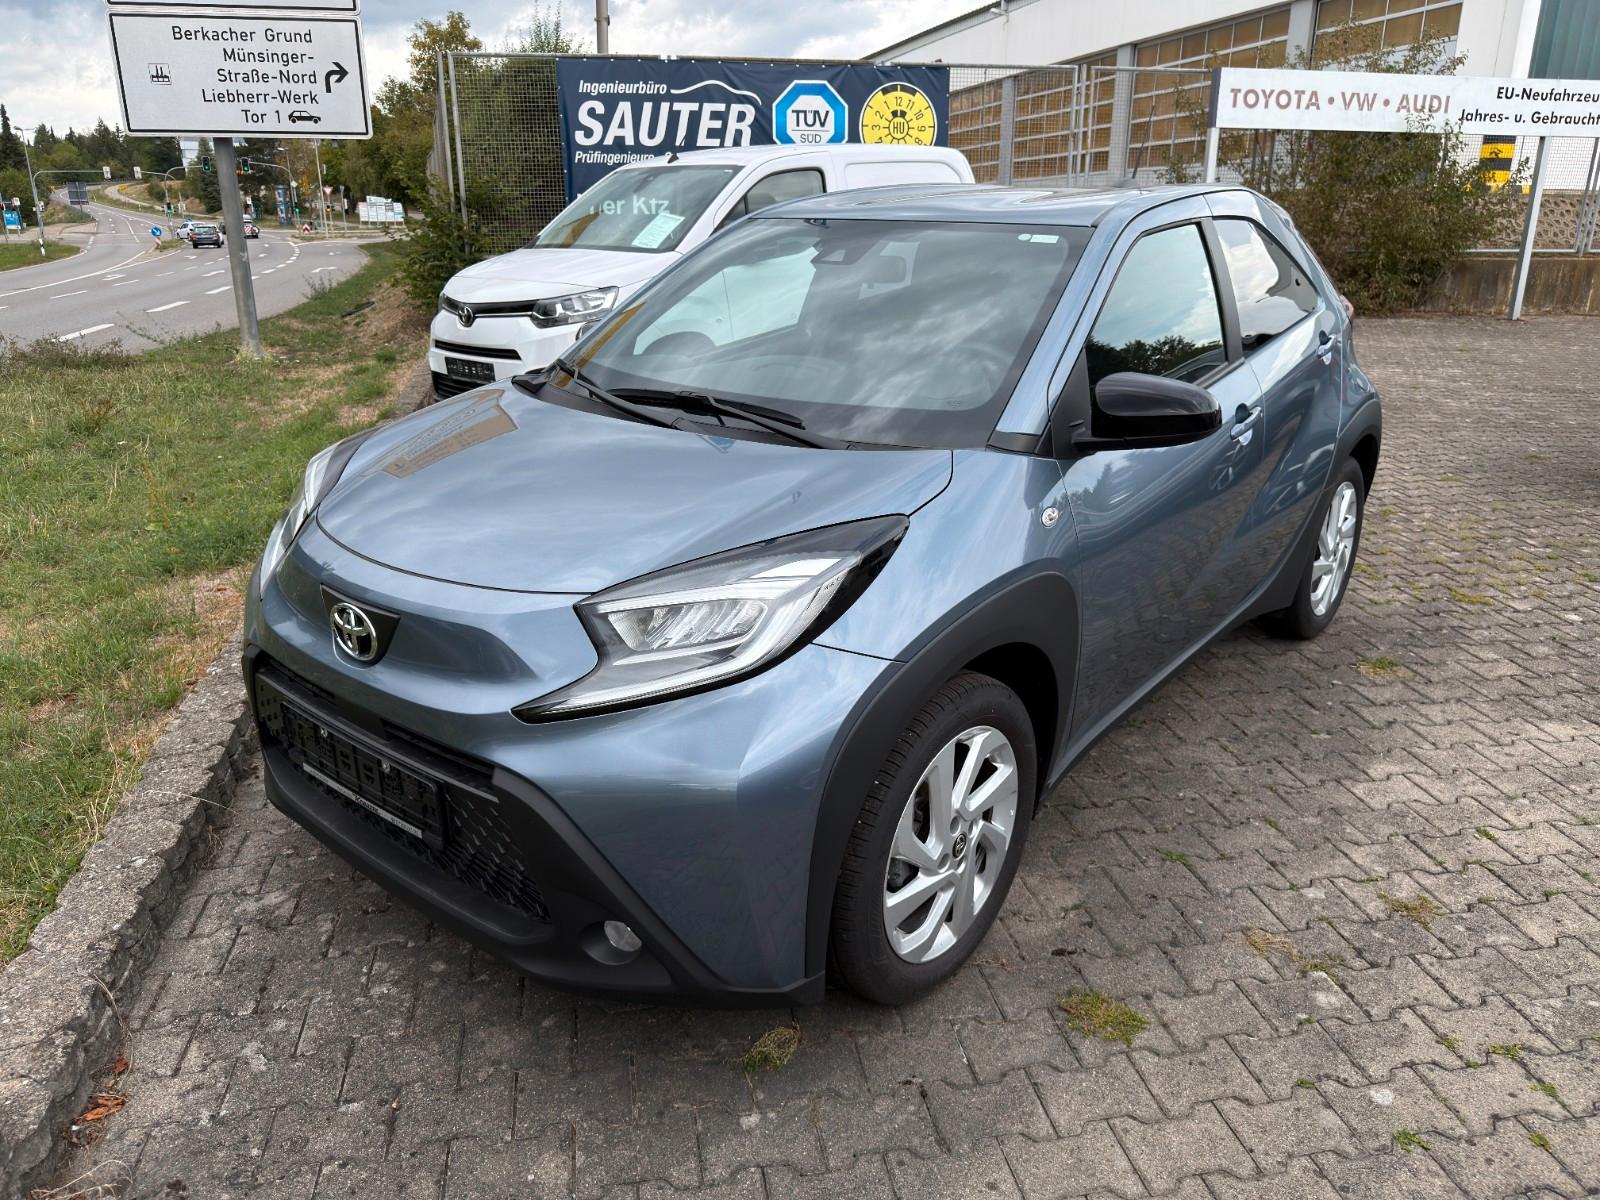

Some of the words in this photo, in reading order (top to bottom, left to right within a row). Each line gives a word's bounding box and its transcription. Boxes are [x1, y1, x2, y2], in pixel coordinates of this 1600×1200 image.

[172, 26, 256, 42] Berkacher
[264, 28, 313, 43] Grund
[223, 48, 314, 67] Münsinger-
[217, 69, 318, 84] Straße-Nord
[578, 80, 668, 95] Ingenieurbüro
[1496, 86, 1600, 103] EU-Neufahrzeu
[202, 89, 319, 105] Liebherr-Werk
[895, 96, 903, 107] 12
[1230, 88, 1321, 111] TOYOTA
[1341, 91, 1378, 112] VW
[1396, 93, 1451, 114] AUDI
[884, 100, 890, 110] 1
[906, 99, 915, 111] 11
[241, 109, 267, 123] Tor
[275, 110, 281, 124] 1
[792, 109, 830, 128] TÜV
[875, 110, 884, 120] 2
[914, 109, 924, 121] 10
[1459, 108, 1510, 123] Jahres-
[1514, 114, 1526, 124] u.
[574, 100, 756, 148] SAUTER
[893, 121, 905, 134] HU
[800, 133, 822, 144] SÜD
